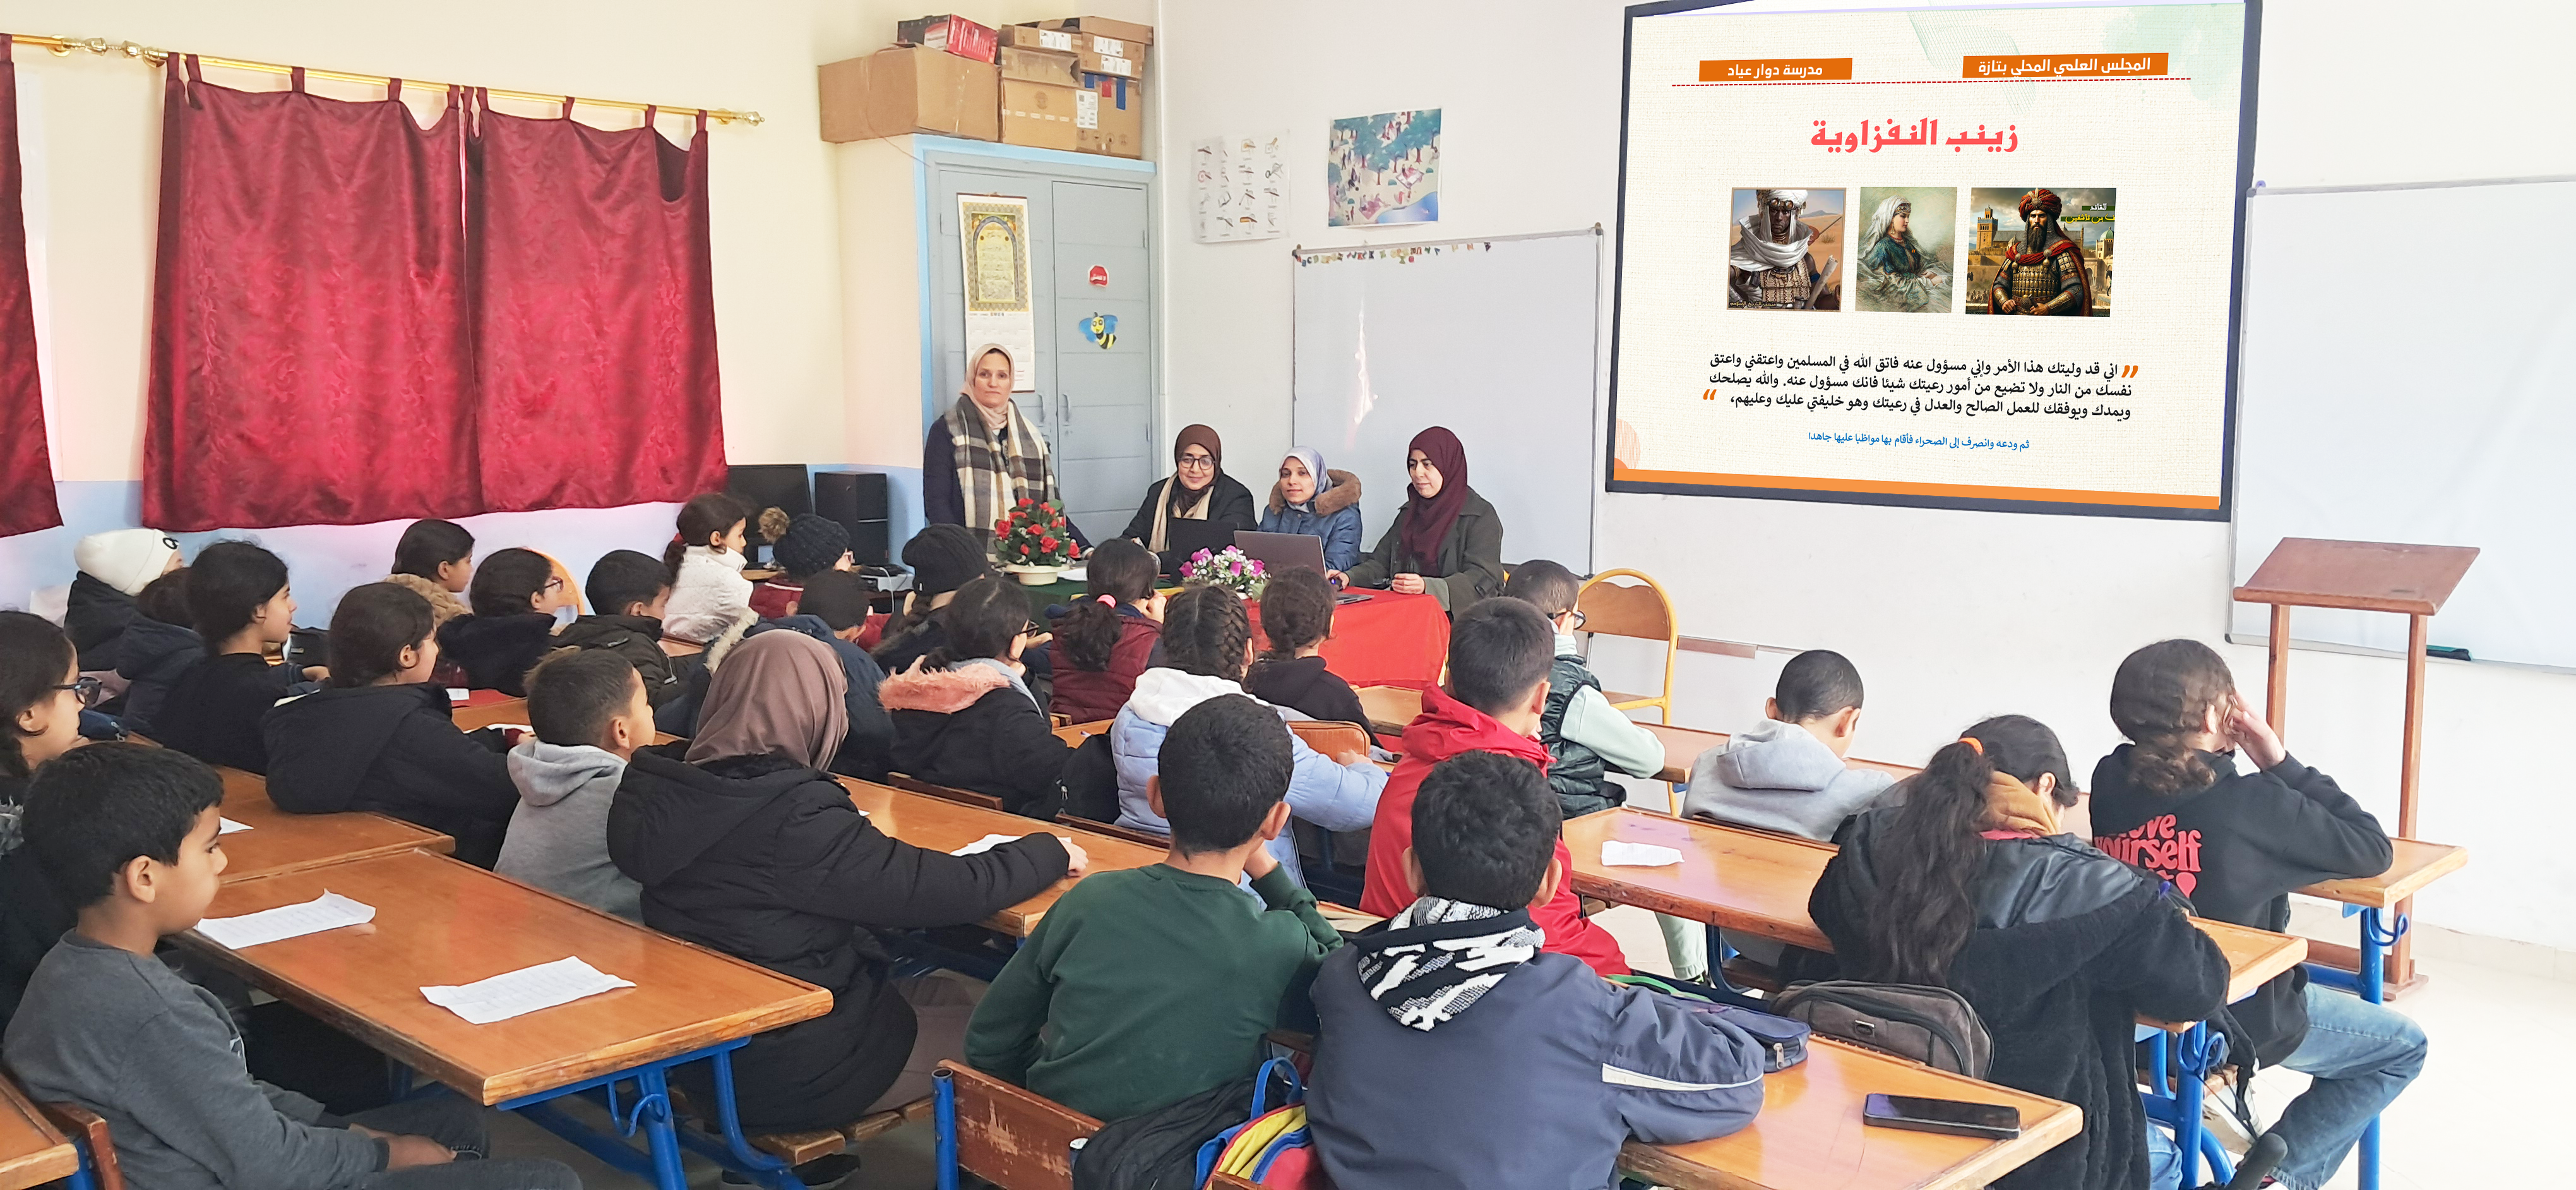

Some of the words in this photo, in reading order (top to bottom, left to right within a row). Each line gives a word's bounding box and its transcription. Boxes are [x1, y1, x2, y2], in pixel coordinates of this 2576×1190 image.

[1728, 64, 1751, 78] عياد
[1753, 64, 1779, 78] دوار
[1783, 65, 1822, 78] مدرسة
[1979, 60, 2007, 75] بتازة
[2011, 59, 2050, 76] المحلي
[2054, 59, 2097, 76] العلمي
[2101, 57, 2150, 73] المجلس
[1811, 117, 1938, 153] النفزاوية
[1945, 124, 2017, 152] زينب
[1710, 354, 1741, 367] واعتق
[1745, 354, 1783, 371] واعتقني
[1787, 356, 1835, 369] المسلمين
[1839, 356, 1849, 374] في
[1854, 354, 1871, 368] الله
[1876, 356, 1899, 372] فاتق
[1904, 360, 1923, 369] عنه
[1927, 359, 1966, 374] مسؤول
[1993, 359, 2020, 376] الأمر
[2024, 360, 2043, 373] هذا
[1971, 359, 1991, 378] وإني
[2048, 363, 2081, 377] وليتك
[2085, 362, 2099, 374] قد
[2104, 363, 2117, 382] اني
[1710, 372, 1751, 387] يصلحك
[1756, 371, 1778, 388] والله
[1810, 375, 1848, 390] مسؤول
[1853, 376, 1878, 387] فانك
[1882, 378, 1905, 392] شيئا
[1909, 378, 1943, 393] رعيتك
[1946, 377, 1971, 395] أمور
[1975, 383, 1990, 395] من
[1995, 382, 2025, 397] تضيع
[2029, 382, 2044, 397] ولا
[2048, 383, 2070, 397] النار
[2075, 387, 2091, 399] من
[2096, 384, 2131, 396] نفسك
[1776, 394, 1803, 407] عليك
[1808, 395, 1844, 412] خليفتي
[1846, 399, 1868, 411] وهو
[1873, 397, 1907, 411] رعيتك
[1911, 397, 1920, 416] في
[1925, 399, 1962, 414] والعدل
[1966, 400, 2003, 416] الصالح
[2007, 401, 2039, 416] للعمل
[2044, 402, 2087, 420] ويوفقك
[2092, 404, 2130, 421] ويمدك
[1809, 432, 1832, 442] جاهدا
[1834, 433, 1853, 443] عليها
[1856, 433, 1880, 445] مواظبا
[1881, 435, 1892, 445] بها
[1895, 433, 1913, 447] فأقام
[1916, 436, 1947, 447] الصحراء
[1962, 436, 1994, 450] وانصرف
[1996, 441, 2017, 450] ودعه
[2020, 440, 2029, 452] ثم
[2118, 814, 2176, 839] ove
